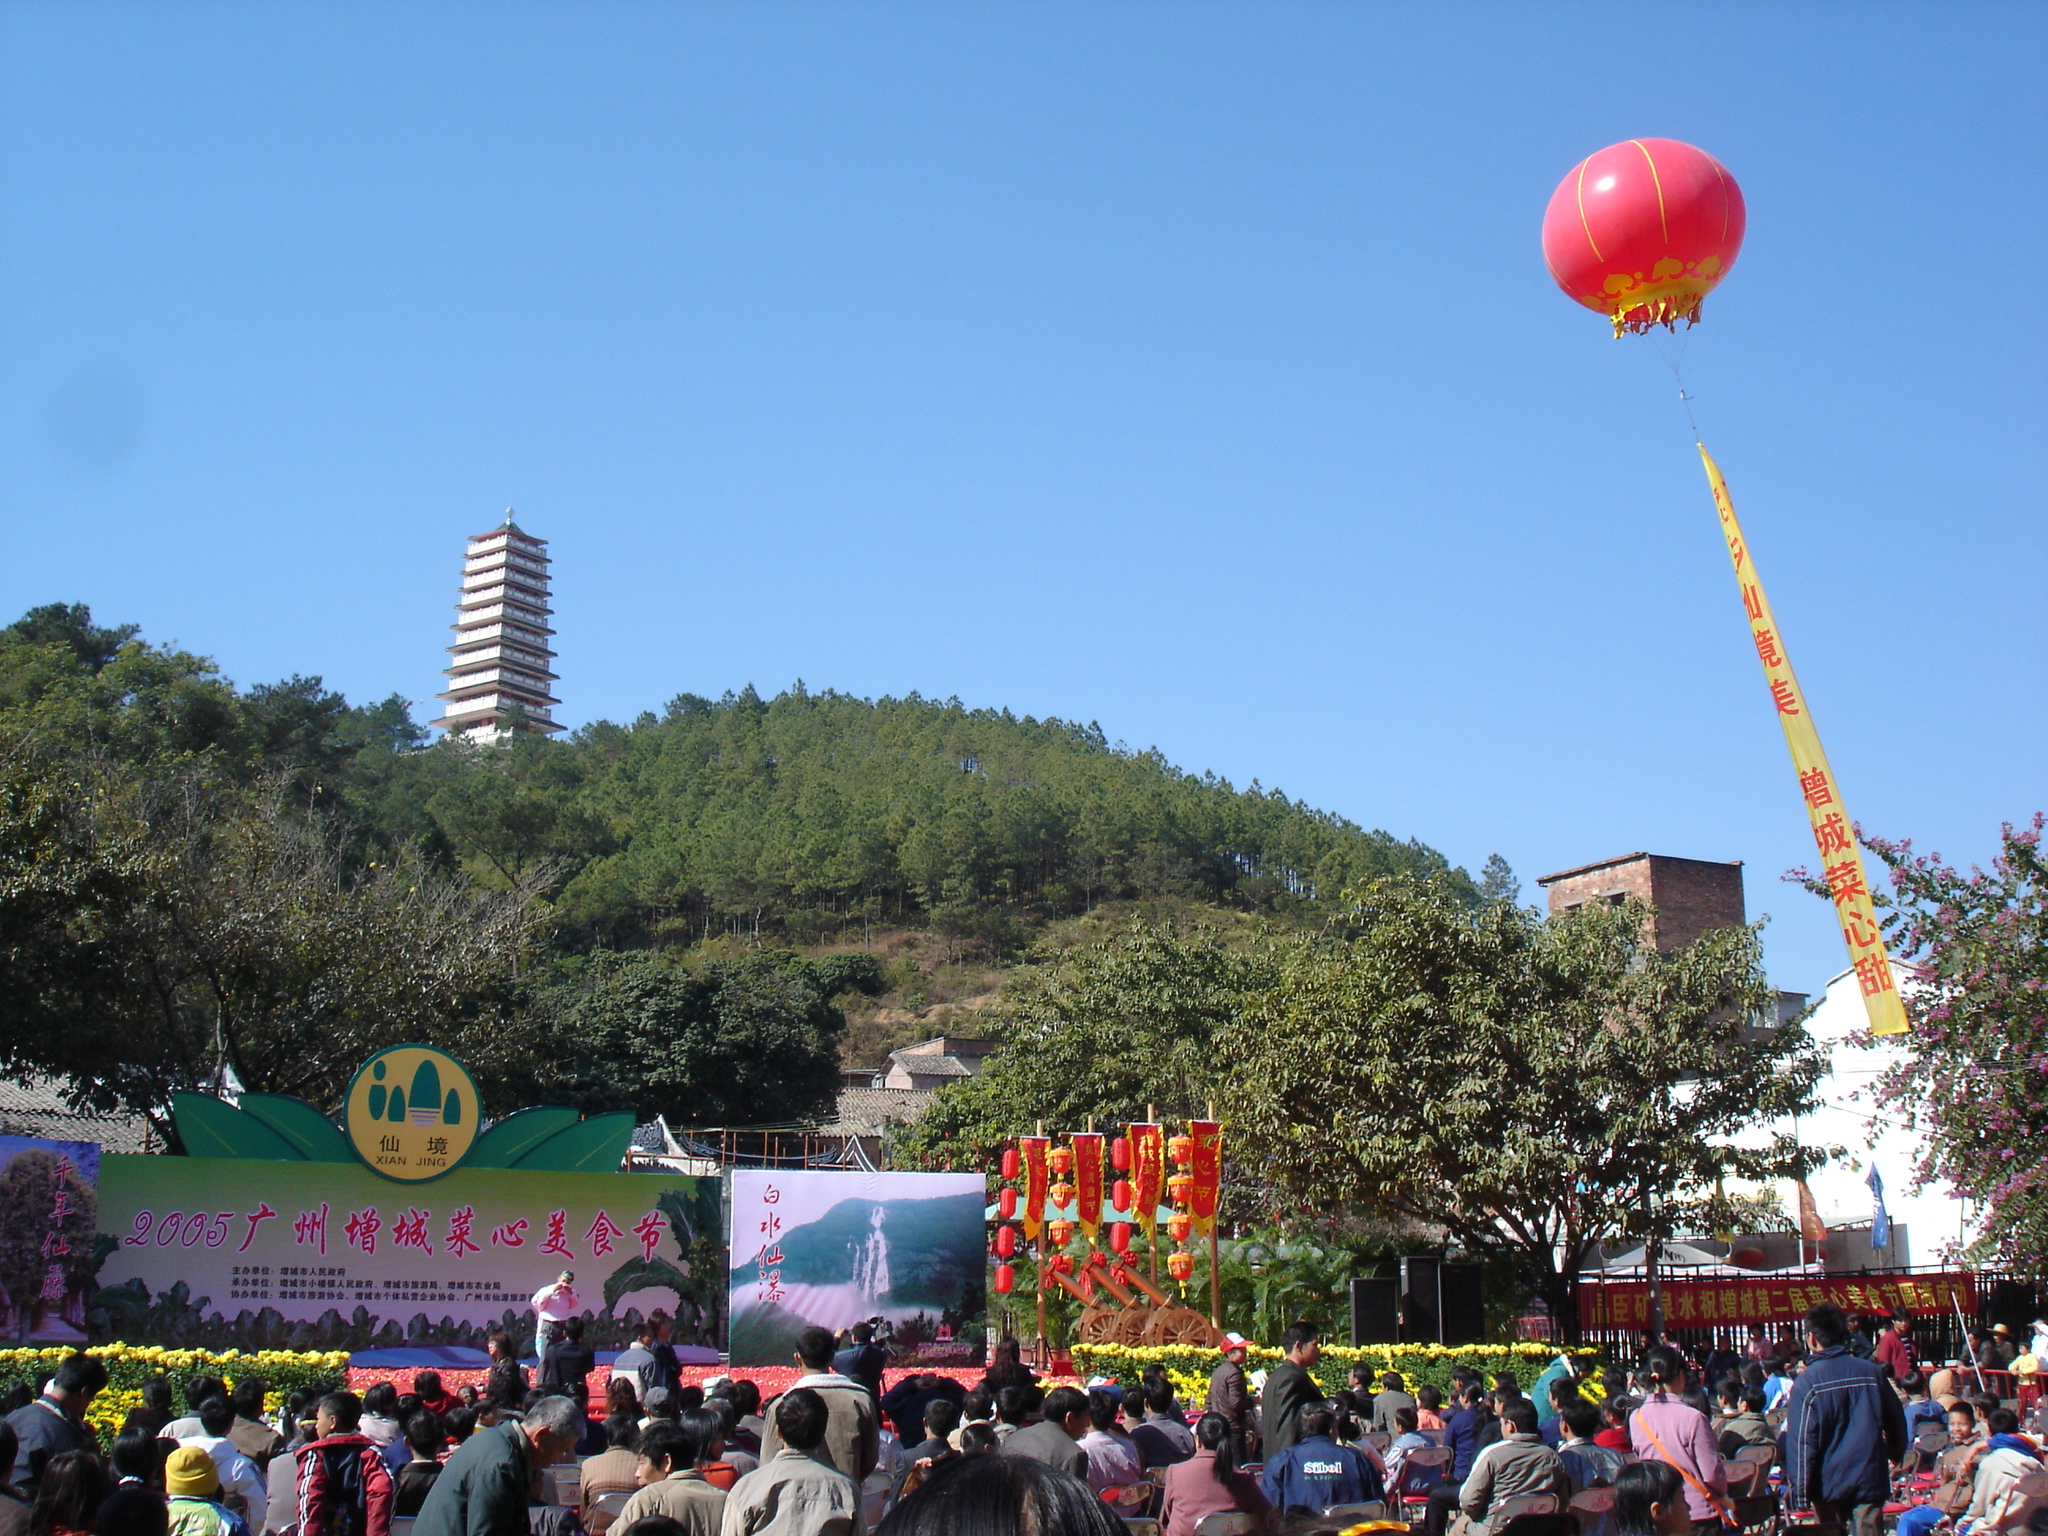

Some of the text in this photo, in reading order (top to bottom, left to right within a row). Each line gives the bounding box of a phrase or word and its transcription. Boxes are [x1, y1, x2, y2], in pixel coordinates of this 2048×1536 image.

[376, 1155, 446, 1167] XIAN JING
[379, 1134, 449, 1156] 仙境
[40, 1155, 75, 1301] 千年仙藤
[124, 1201, 668, 1262] 2005广州增城菜心美食节
[756, 1184, 786, 1302] 白水仙瀑
